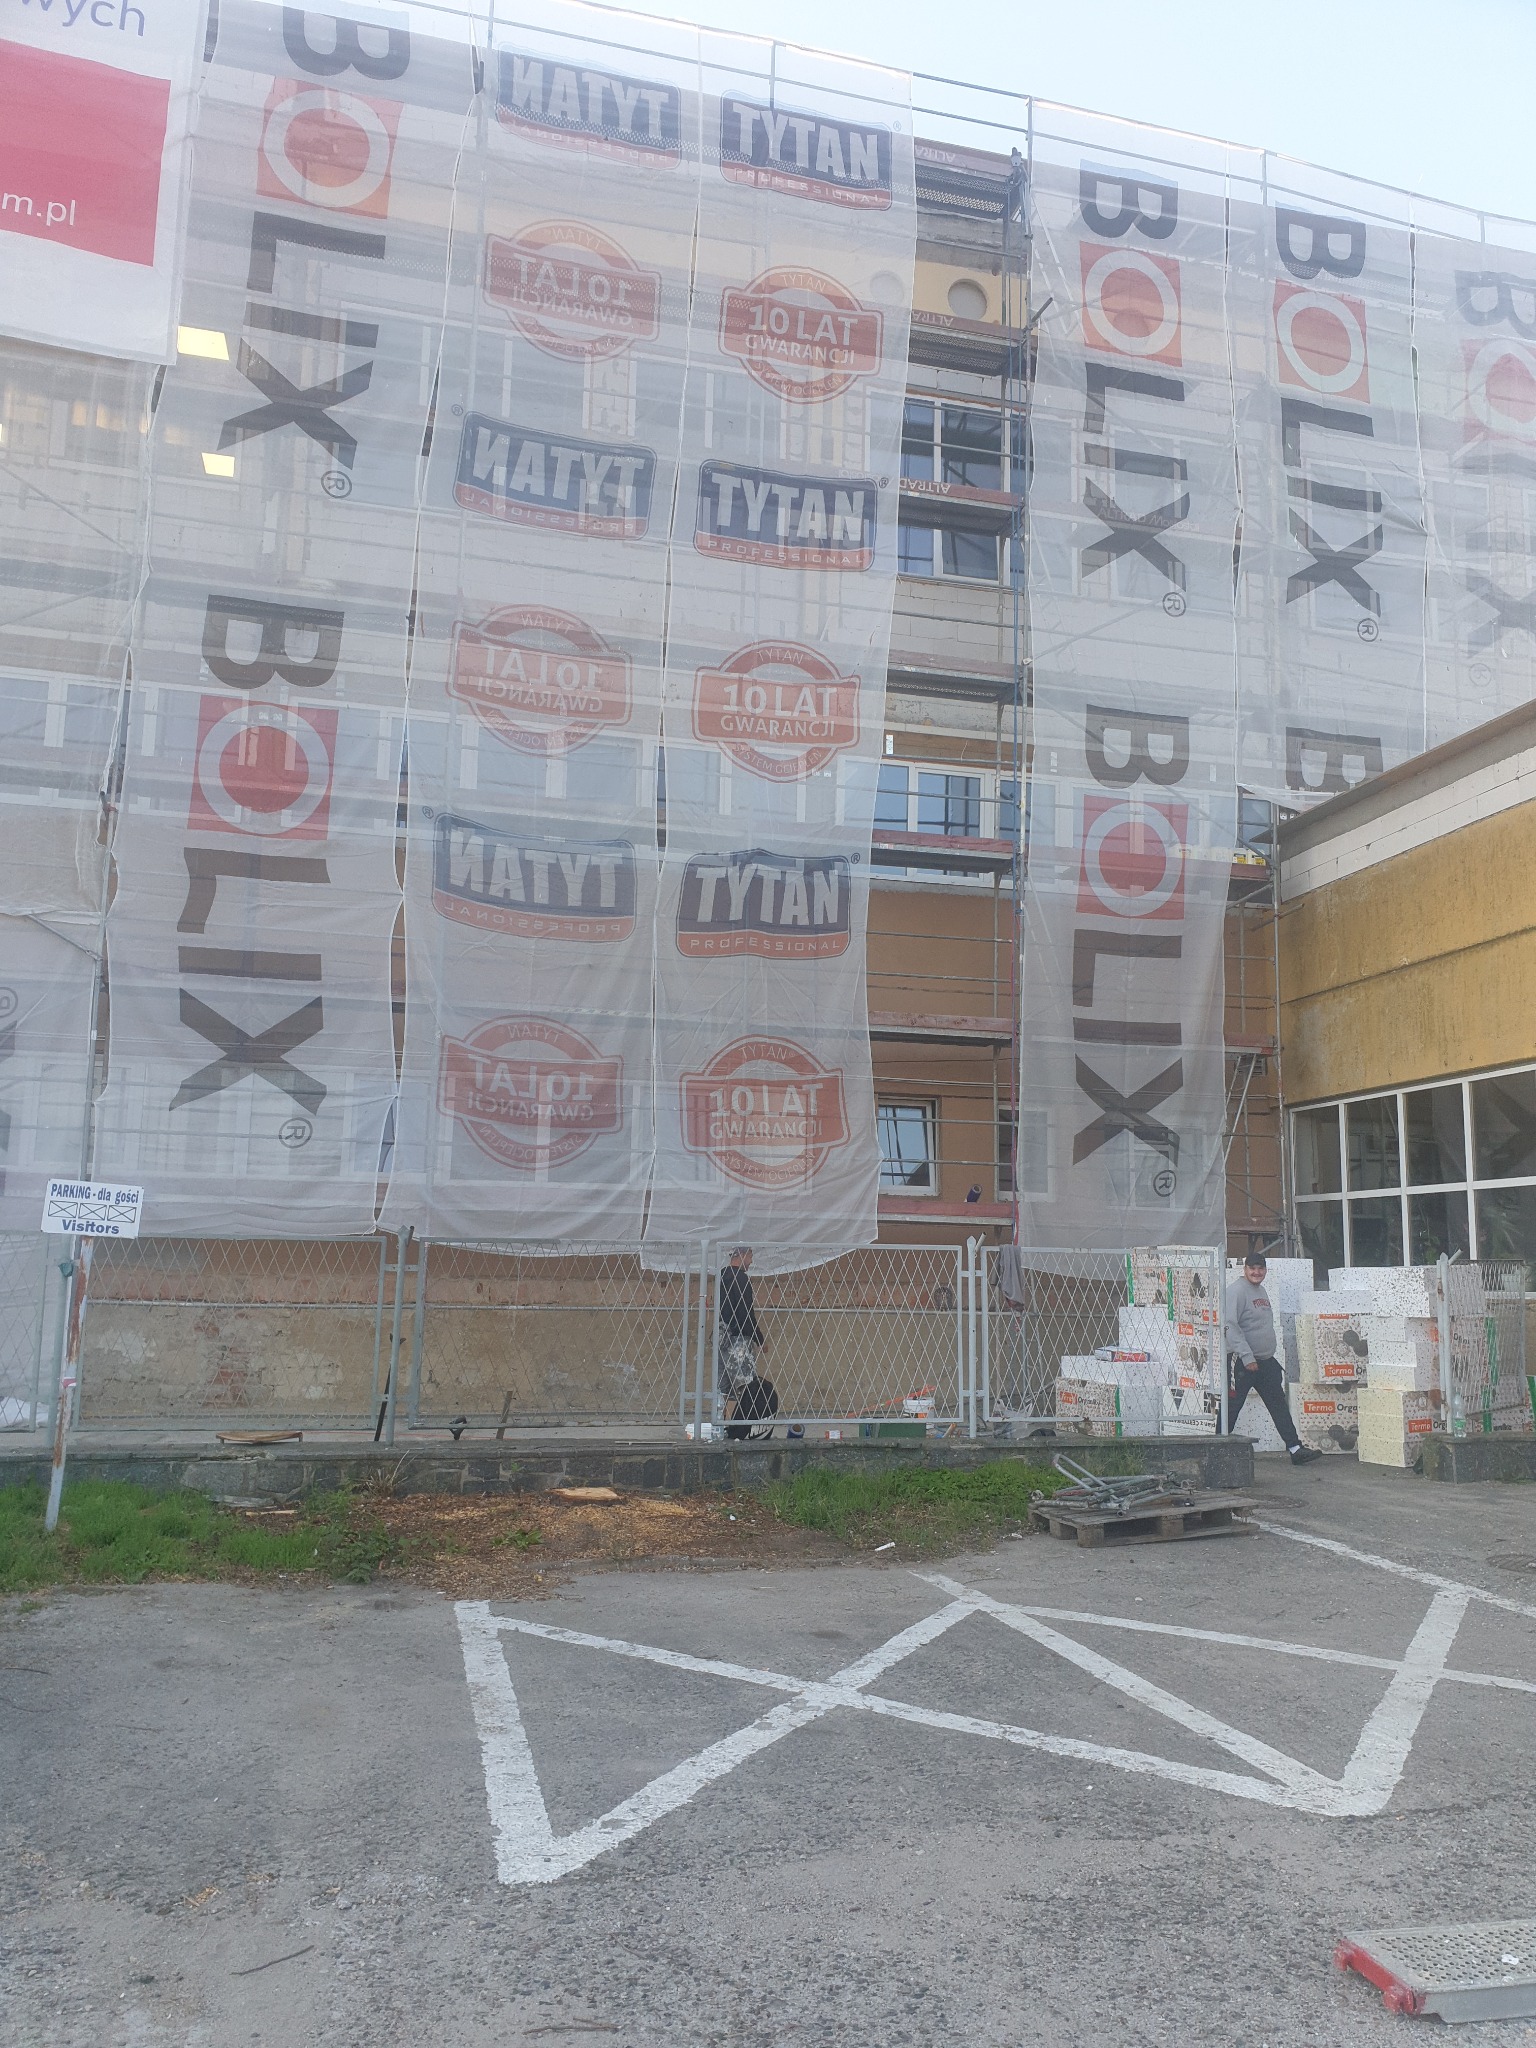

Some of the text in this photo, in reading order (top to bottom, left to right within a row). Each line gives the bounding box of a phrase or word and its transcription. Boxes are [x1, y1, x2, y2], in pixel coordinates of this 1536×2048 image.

[732, 101, 879, 181] TYTAN
[914, 144, 956, 163] ALTRA
[217, 3, 411, 471] BOLIX
[780, 274, 827, 293] TYTAN
[749, 304, 859, 347] 10 LAT
[912, 311, 954, 327] ALTRA
[745, 334, 855, 365] GWARANCJI
[1080, 158, 1190, 594] BOLIX
[1272, 202, 1384, 618] BOLIX
[899, 478, 951, 495] ALTRAD
[711, 472, 865, 542] TYTAN
[707, 540, 865, 564] PROFESSIONAL
[756, 648, 804, 664] TYTAN
[722, 684, 838, 718] 10 LAT
[720, 715, 835, 738] GWARANCJI
[169, 594, 346, 1116] BOLIX
[695, 863, 840, 926] TYTAN
[690, 937, 841, 951] PROFESSIONAL
[1072, 703, 1190, 1168] BOLIX
[738, 1044, 788, 1061] TYTAN
[709, 1082, 824, 1118] 10 LAT
[709, 1119, 823, 1140] GWARANCJI
[50, 1183, 92, 1200] PARKING
[98, 1187, 111, 1202] dla
[115, 1188, 139, 1204] gości
[62, 1219, 120, 1235] Visitors
[1328, 1366, 1353, 1376] Termo
[1306, 1403, 1334, 1412] Termo
